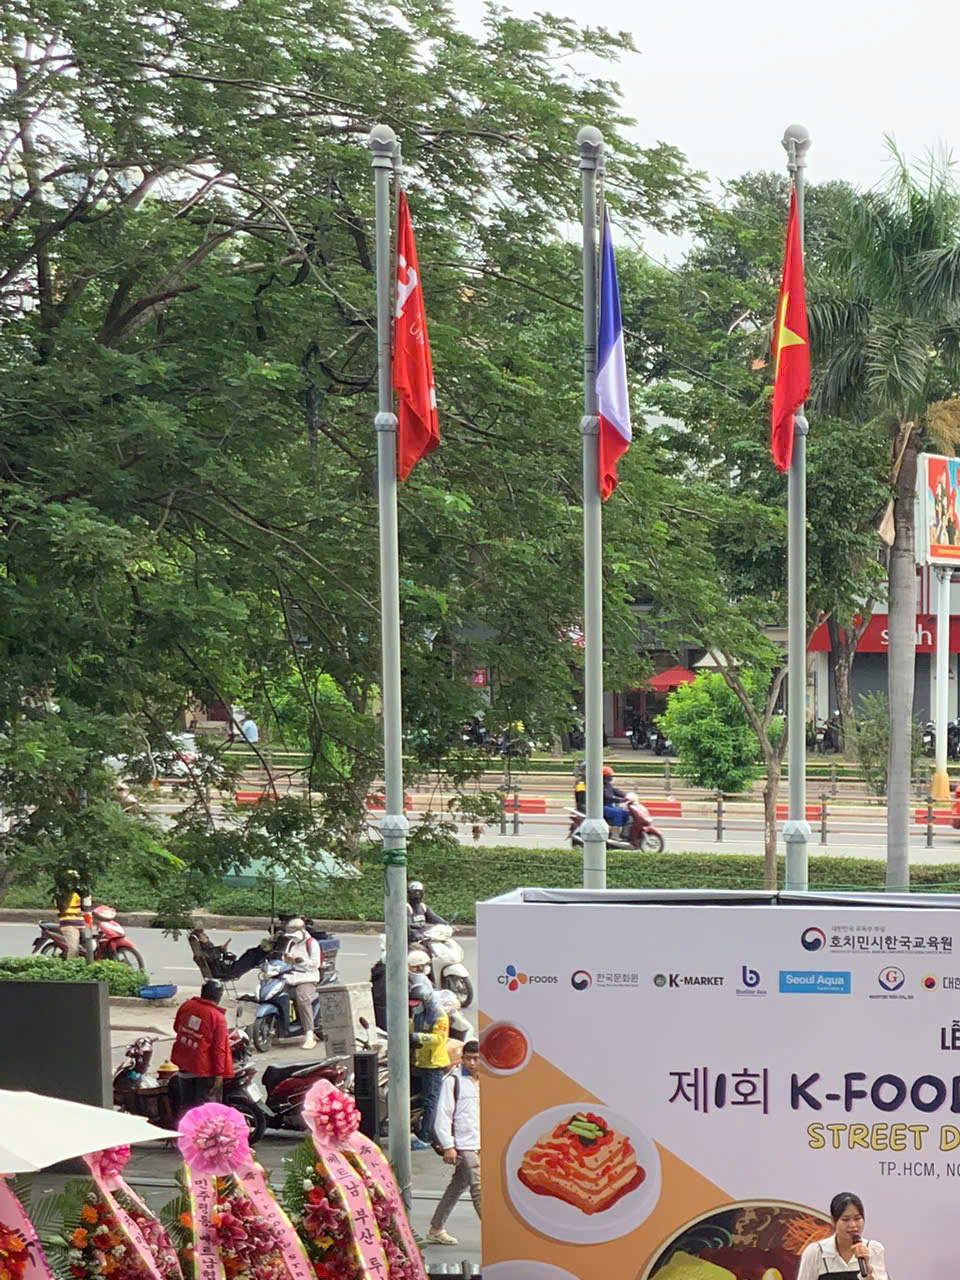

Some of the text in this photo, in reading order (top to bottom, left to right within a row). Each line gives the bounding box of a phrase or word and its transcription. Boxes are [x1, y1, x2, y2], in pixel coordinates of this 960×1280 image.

[829, 935, 953, 951] 호치민시한국교육원
[497, 975, 559, 986] CJ FOODS
[596, 972, 639, 984] 한국문화원
[669, 974, 725, 988] K-MARKET
[785, 974, 845, 986] Seoul Aqua
[941, 1019, 960, 1051] LỄ
[668, 1066, 769, 1115] 제1회
[806, 1122, 929, 1152] STREET
[878, 1161, 941, 1180] TP.HCM,
[327, 1152, 360, 1198] 베트남
[354, 1208, 376, 1246] 부산
